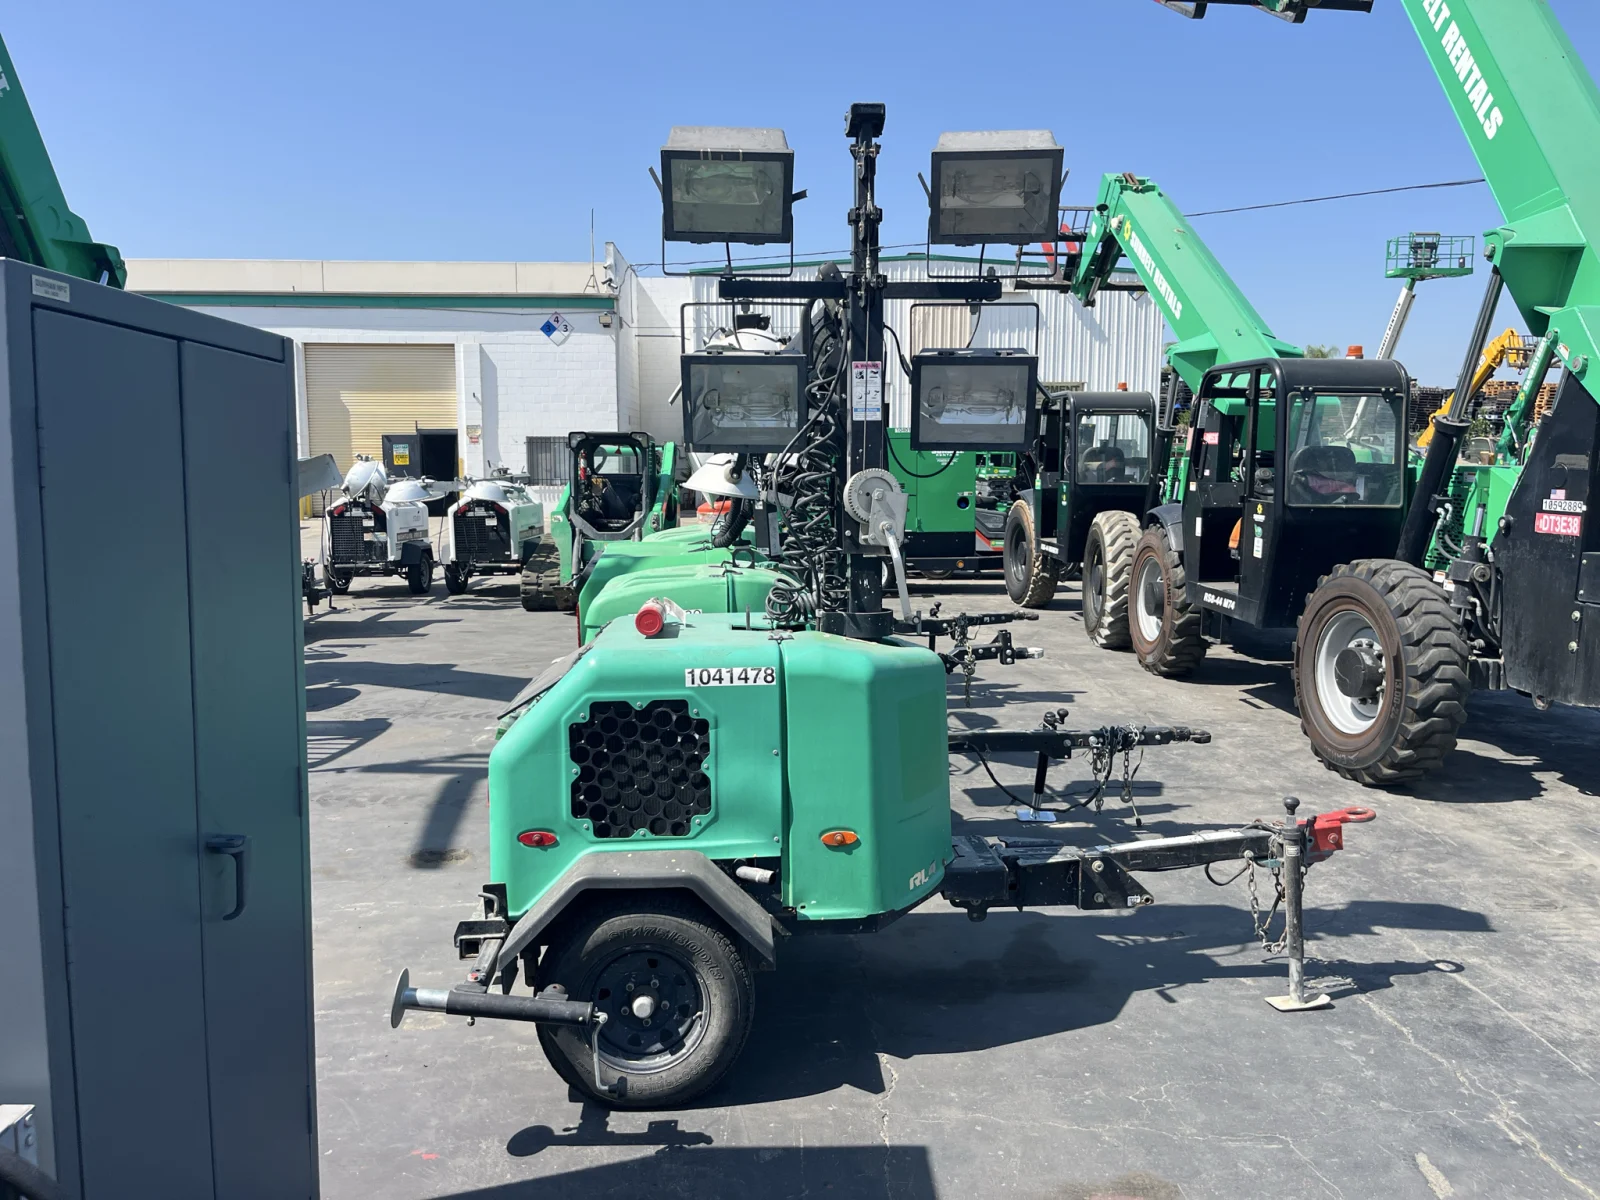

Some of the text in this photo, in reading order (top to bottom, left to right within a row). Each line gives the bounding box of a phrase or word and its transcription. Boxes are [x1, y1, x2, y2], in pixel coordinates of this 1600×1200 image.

[1441, 20, 1503, 140] RENTALS
[1153, 267, 1182, 320] RENTALS
[553, 316, 559, 324] 4
[545, 325, 551, 333] 3
[1544, 501, 1583, 512] 10592889
[687, 667, 775, 685] 1041478
